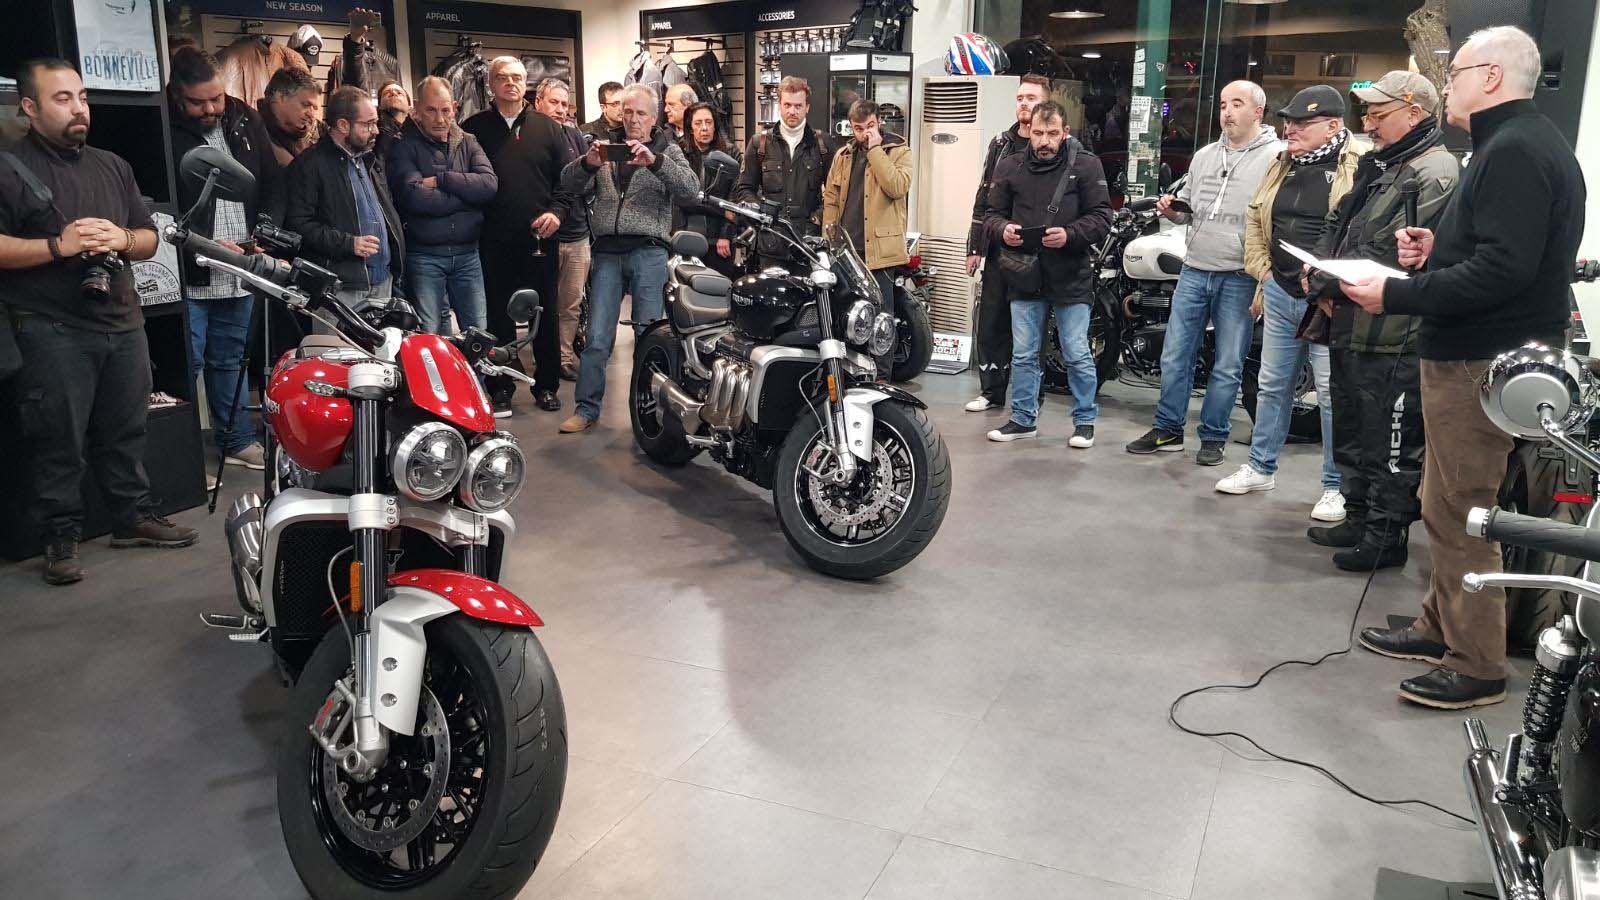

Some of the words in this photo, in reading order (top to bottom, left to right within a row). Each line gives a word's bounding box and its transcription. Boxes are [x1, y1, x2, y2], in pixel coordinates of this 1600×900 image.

[266, 1, 286, 10] NEW
[289, 3, 323, 13] SEASON
[425, 12, 461, 22] APPAREL
[758, 11, 795, 21] ACCESSORIES
[651, 22, 672, 31] APPAREL
[84, 56, 158, 80] BONNEVILLE
[1388, 392, 1406, 473] RICHA
